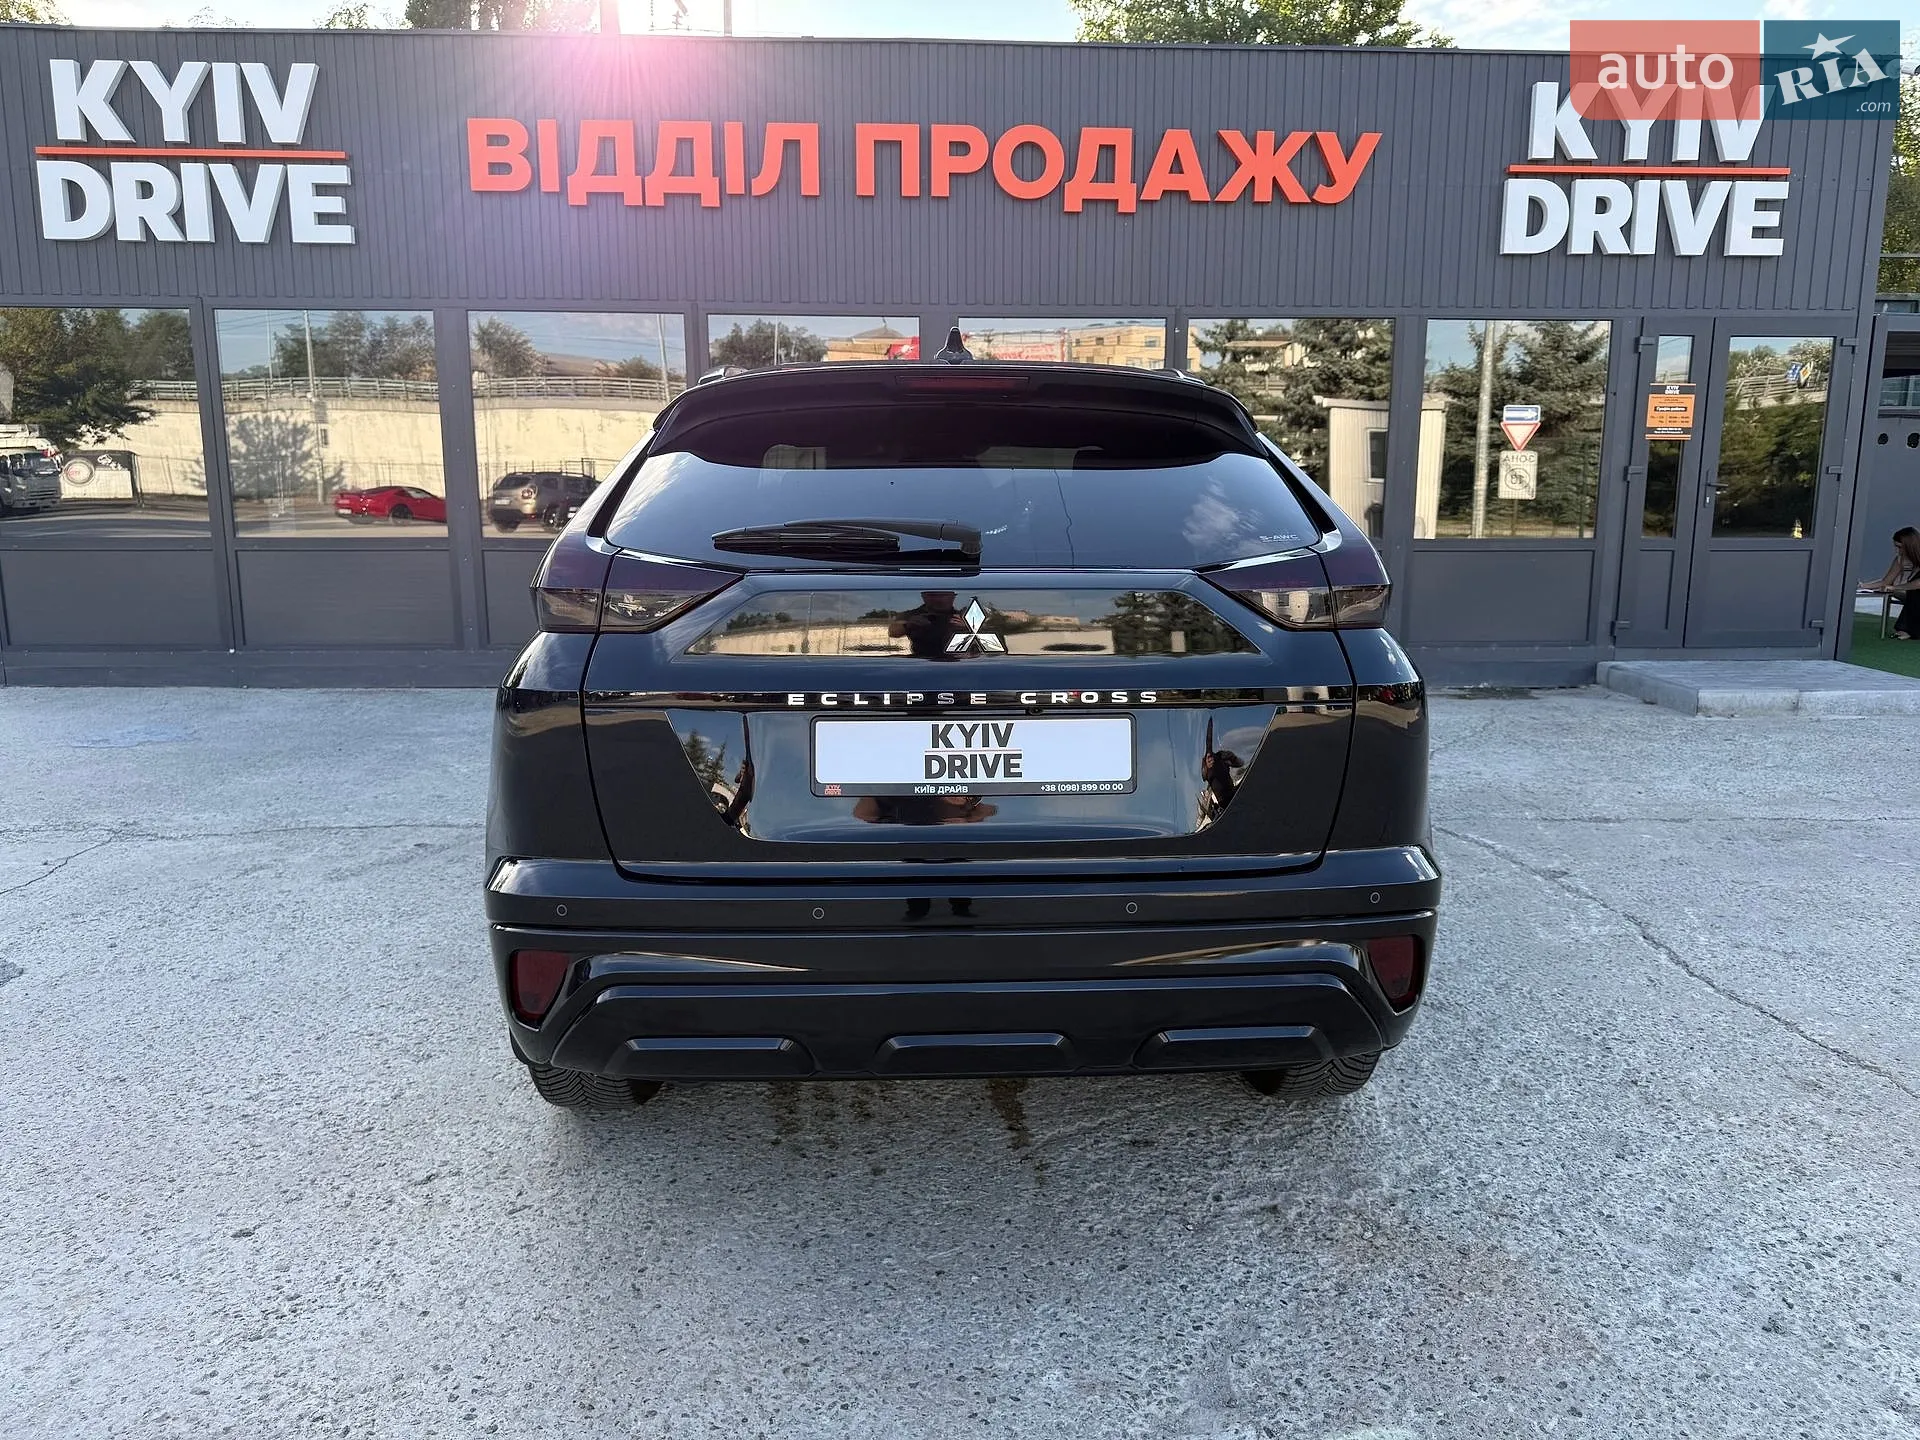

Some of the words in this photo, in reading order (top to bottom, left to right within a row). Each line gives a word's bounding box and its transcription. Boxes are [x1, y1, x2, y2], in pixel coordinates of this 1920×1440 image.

[49, 59, 319, 145] KYIV
[1527, 81, 1776, 162] KYIV
[466, 118, 821, 208] ВІДДІЛ
[855, 122, 1384, 214] ПРОДАЖУ
[36, 160, 356, 245] DRIVE
[1500, 178, 1790, 257] DRIVE
[787, 692, 987, 705] ECLIPSE
[1020, 691, 1157, 704] CROSS
[931, 722, 1015, 749] KYIV
[914, 784, 936, 794] КИЇВ
[937, 784, 969, 795] ДРАЙВ
[924, 753, 1023, 780] DRIVE
[1040, 784, 1056, 792] +38
[1057, 783, 1080, 793] (098)
[1081, 783, 1098, 791] 899
[1099, 783, 1111, 791] 00
[1112, 783, 1124, 791] 00
